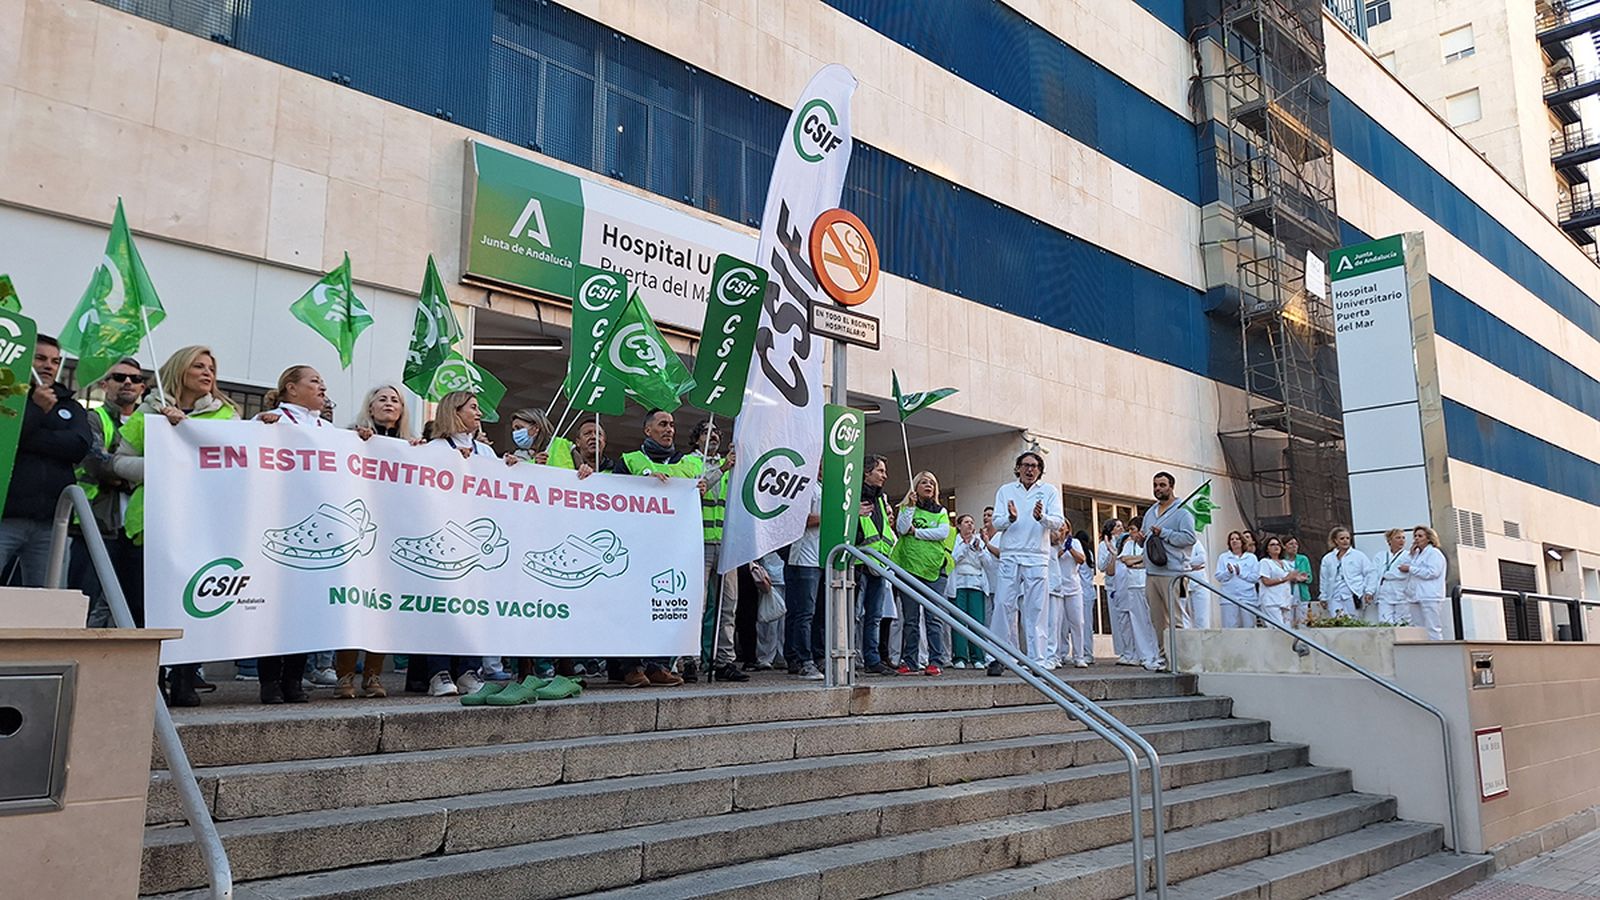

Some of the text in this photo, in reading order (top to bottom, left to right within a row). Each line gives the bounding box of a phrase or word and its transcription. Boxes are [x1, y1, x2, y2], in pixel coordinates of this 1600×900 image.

[803, 115, 842, 153] CSIF
[479, 234, 574, 269] Junta de Andalucía
[602, 223, 692, 271] Hospital
[1354, 251, 1373, 260] Junta
[588, 283, 623, 303] CSIF
[661, 276, 690, 298] del
[726, 279, 760, 299] CSIF
[1335, 283, 1377, 299] Hospital
[757, 199, 818, 407] CSIF
[1336, 291, 1402, 310] Universitario
[815, 309, 824, 317] EN
[825, 312, 842, 322] TODO
[843, 317, 850, 325] EL
[1336, 309, 1370, 321] Puerta
[1337, 319, 1375, 332] del Mar
[706, 313, 743, 405] CSIF
[837, 425, 861, 443] CSIF
[199, 446, 675, 514] EN ESTE CENTRO FALTA PERSONAL
[758, 467, 810, 500] CSIF
[197, 575, 250, 597] CSIF
[329, 587, 360, 605] NO
[399, 595, 490, 616] ZUECOS
[496, 599, 570, 619] VACÍOS
[651, 597, 689, 607] tu voto
[651, 612, 688, 621] palabra
